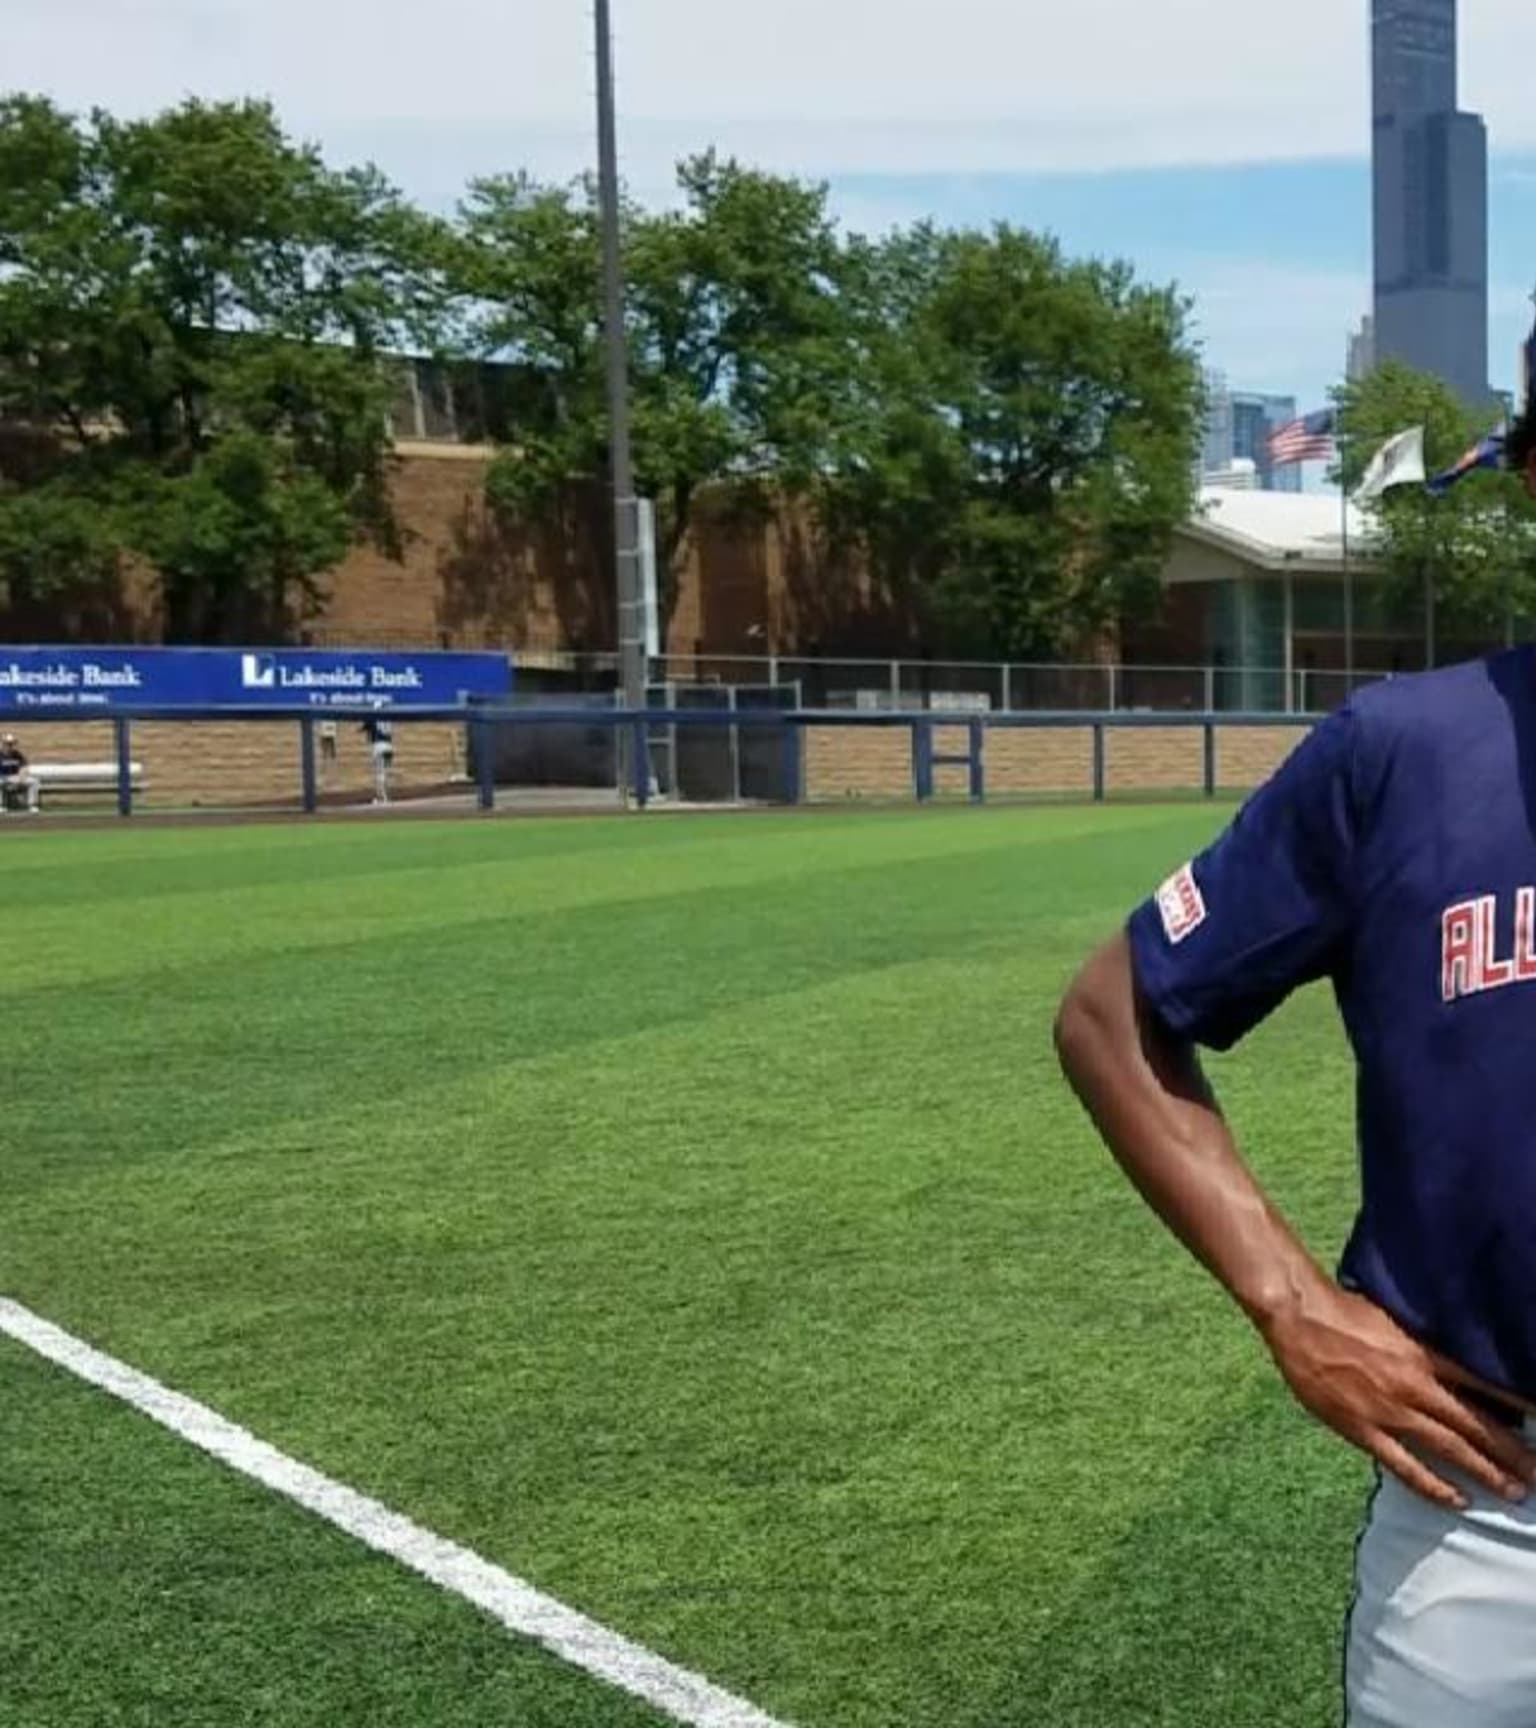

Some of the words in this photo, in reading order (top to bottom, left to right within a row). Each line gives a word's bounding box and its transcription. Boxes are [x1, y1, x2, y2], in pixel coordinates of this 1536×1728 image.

[0, 663, 80, 687] akeside
[82, 663, 142, 687] Bank
[279, 666, 366, 688] Lakeside
[371, 666, 423, 688] Bank
